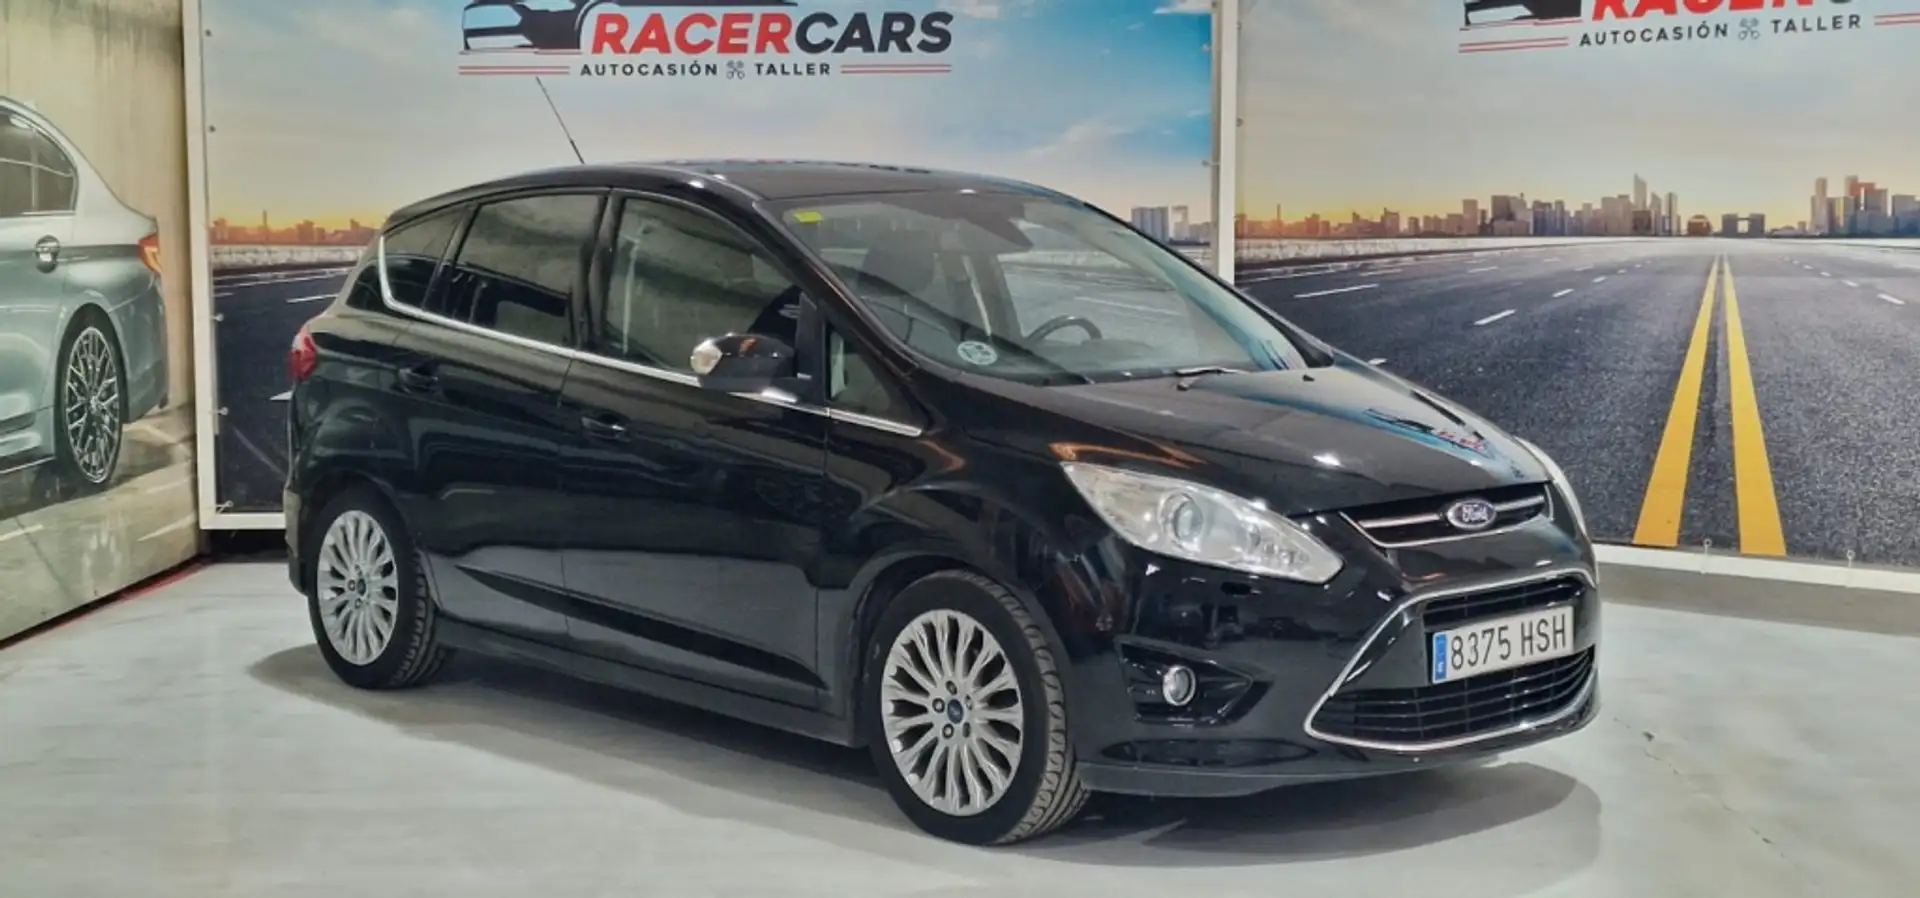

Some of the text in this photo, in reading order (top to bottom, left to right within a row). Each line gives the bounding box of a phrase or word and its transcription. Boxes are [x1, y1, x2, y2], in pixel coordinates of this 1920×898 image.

[591, 11, 954, 55] RACERCARS
[1579, 14, 1862, 47] AUTOCASIÓN TALLER
[580, 60, 832, 77] AUTOCASIÓN TALLER
[1451, 613, 1566, 670] 8375 HSH
